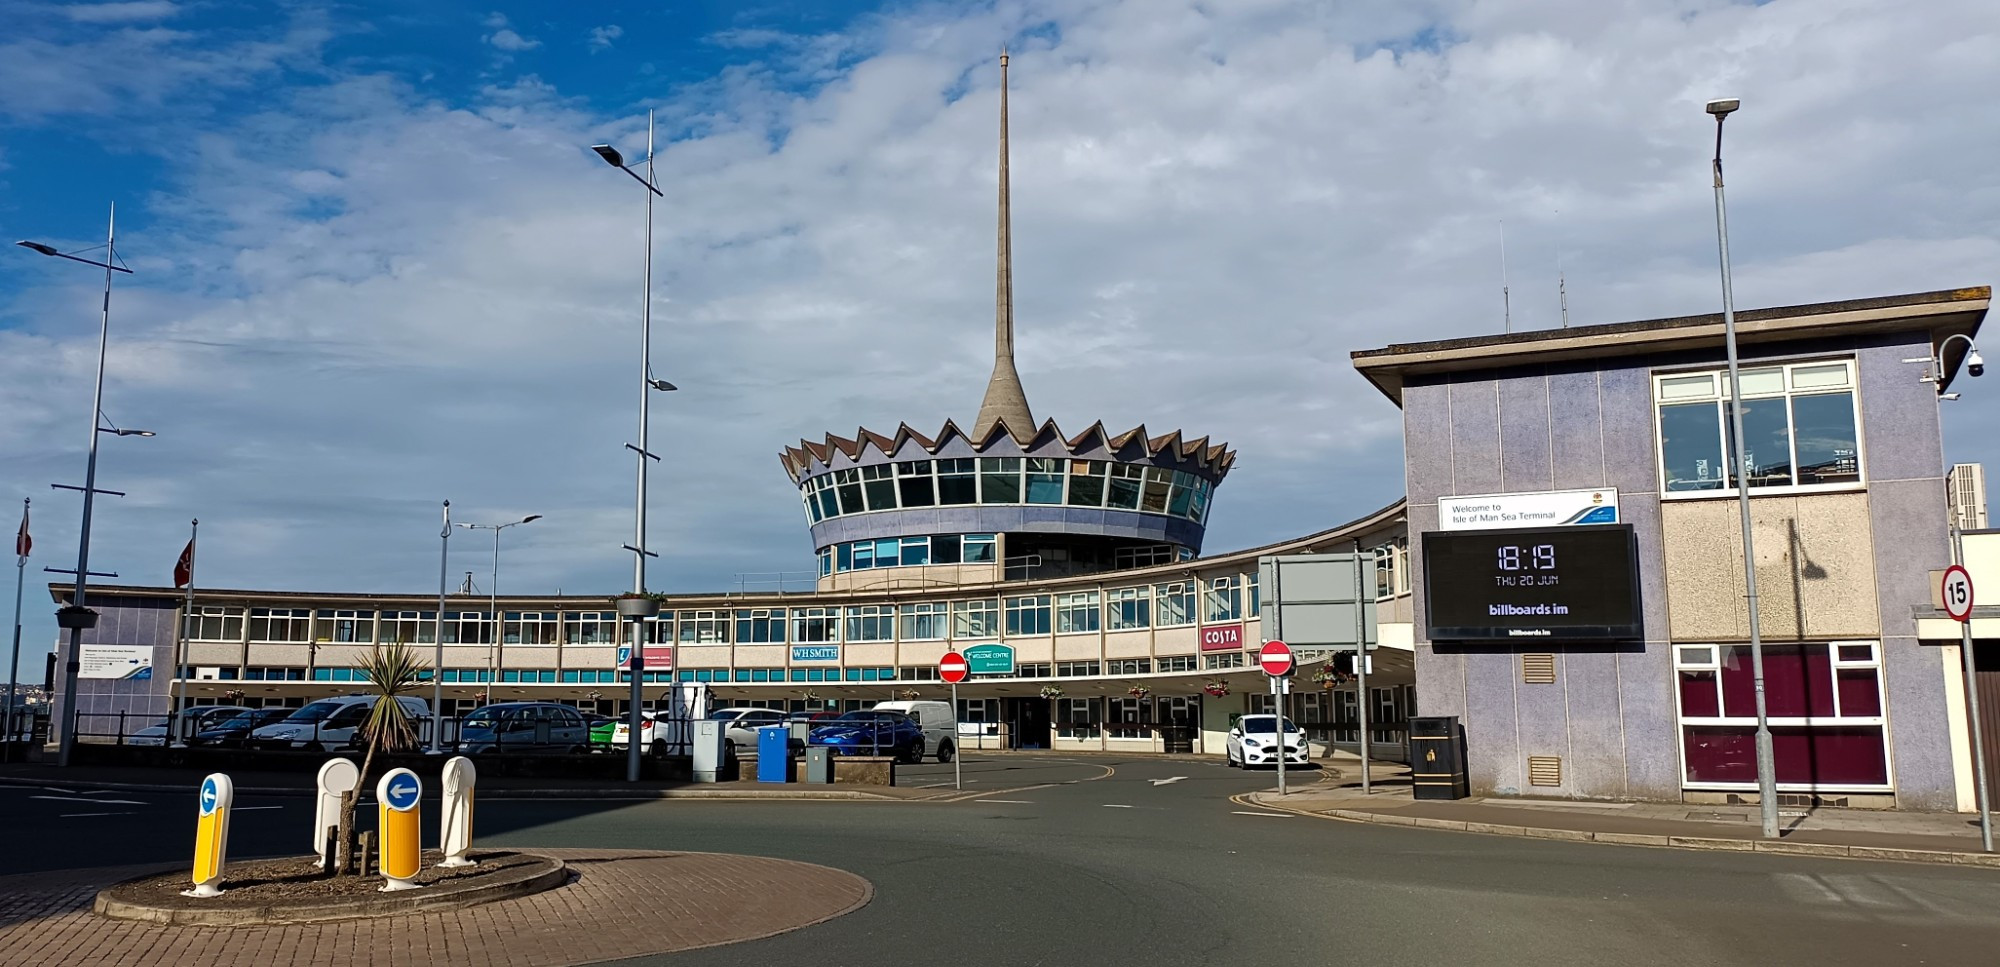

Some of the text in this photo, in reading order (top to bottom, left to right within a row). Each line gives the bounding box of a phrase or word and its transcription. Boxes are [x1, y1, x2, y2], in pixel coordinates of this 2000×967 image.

[1452, 504, 1490, 513] Welcome
[1452, 511, 1556, 523] Isle of Man Sea Terminal
[1497, 544, 1556, 571] 18:19
[1495, 575, 1559, 587] THU 20 JUN
[1948, 581, 1967, 605] 15
[1488, 603, 1569, 616] billboards.im
[1205, 629, 1238, 644] COSTA
[1508, 629, 1552, 637] billboards.im
